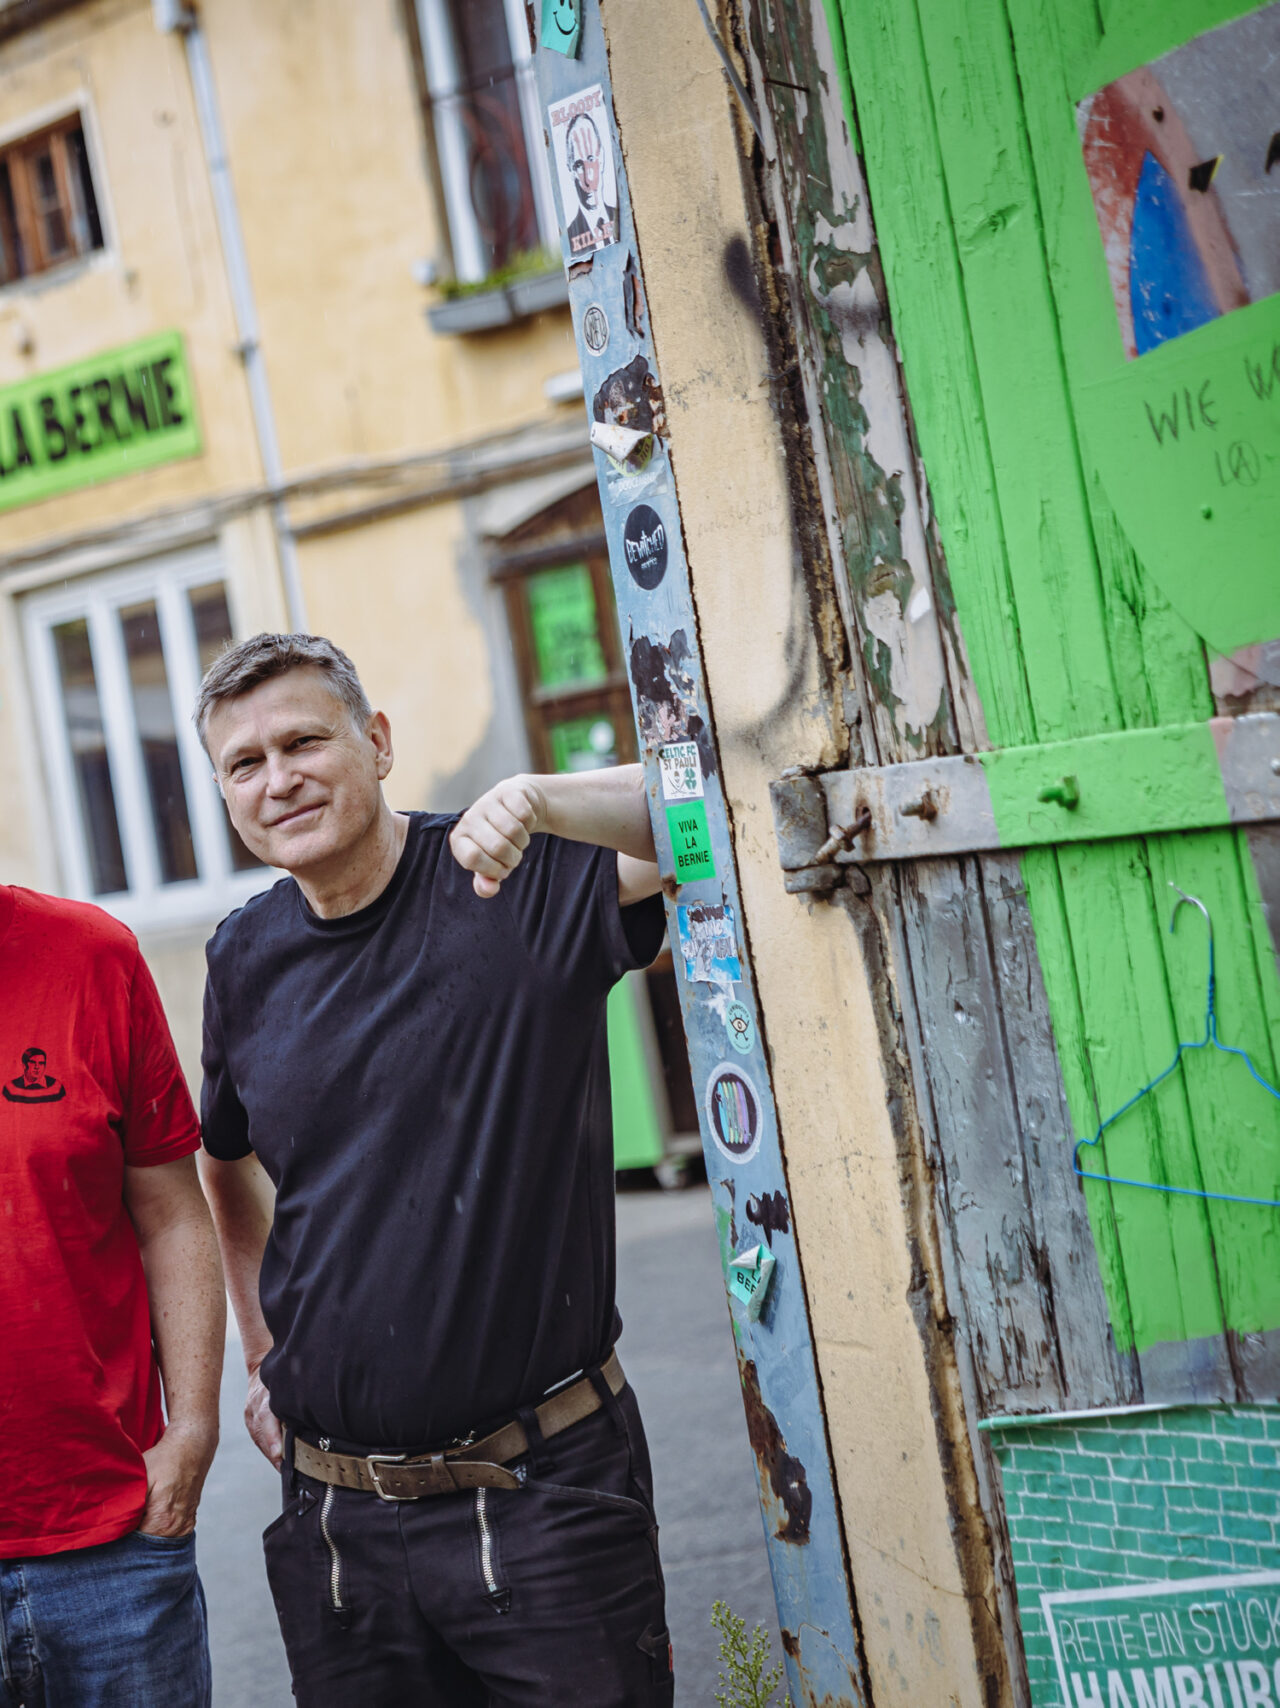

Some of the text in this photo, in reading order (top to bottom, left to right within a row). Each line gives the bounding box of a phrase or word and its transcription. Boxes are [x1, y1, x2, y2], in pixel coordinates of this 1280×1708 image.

[551, 91, 602, 127] BLOODY
[38, 355, 184, 464] BERNIE
[1143, 379, 1218, 445] WIE
[659, 745, 696, 759] CELTIC FC
[663, 755, 697, 770] ST PAULI
[678, 819, 698, 834] VIVA
[685, 836, 697, 849] LA
[677, 850, 709, 868] BERNIE
[1059, 1615, 1139, 1663] RETTE
[1140, 1610, 1186, 1658] EIN
[1070, 1657, 1280, 1708] HAMBUR
